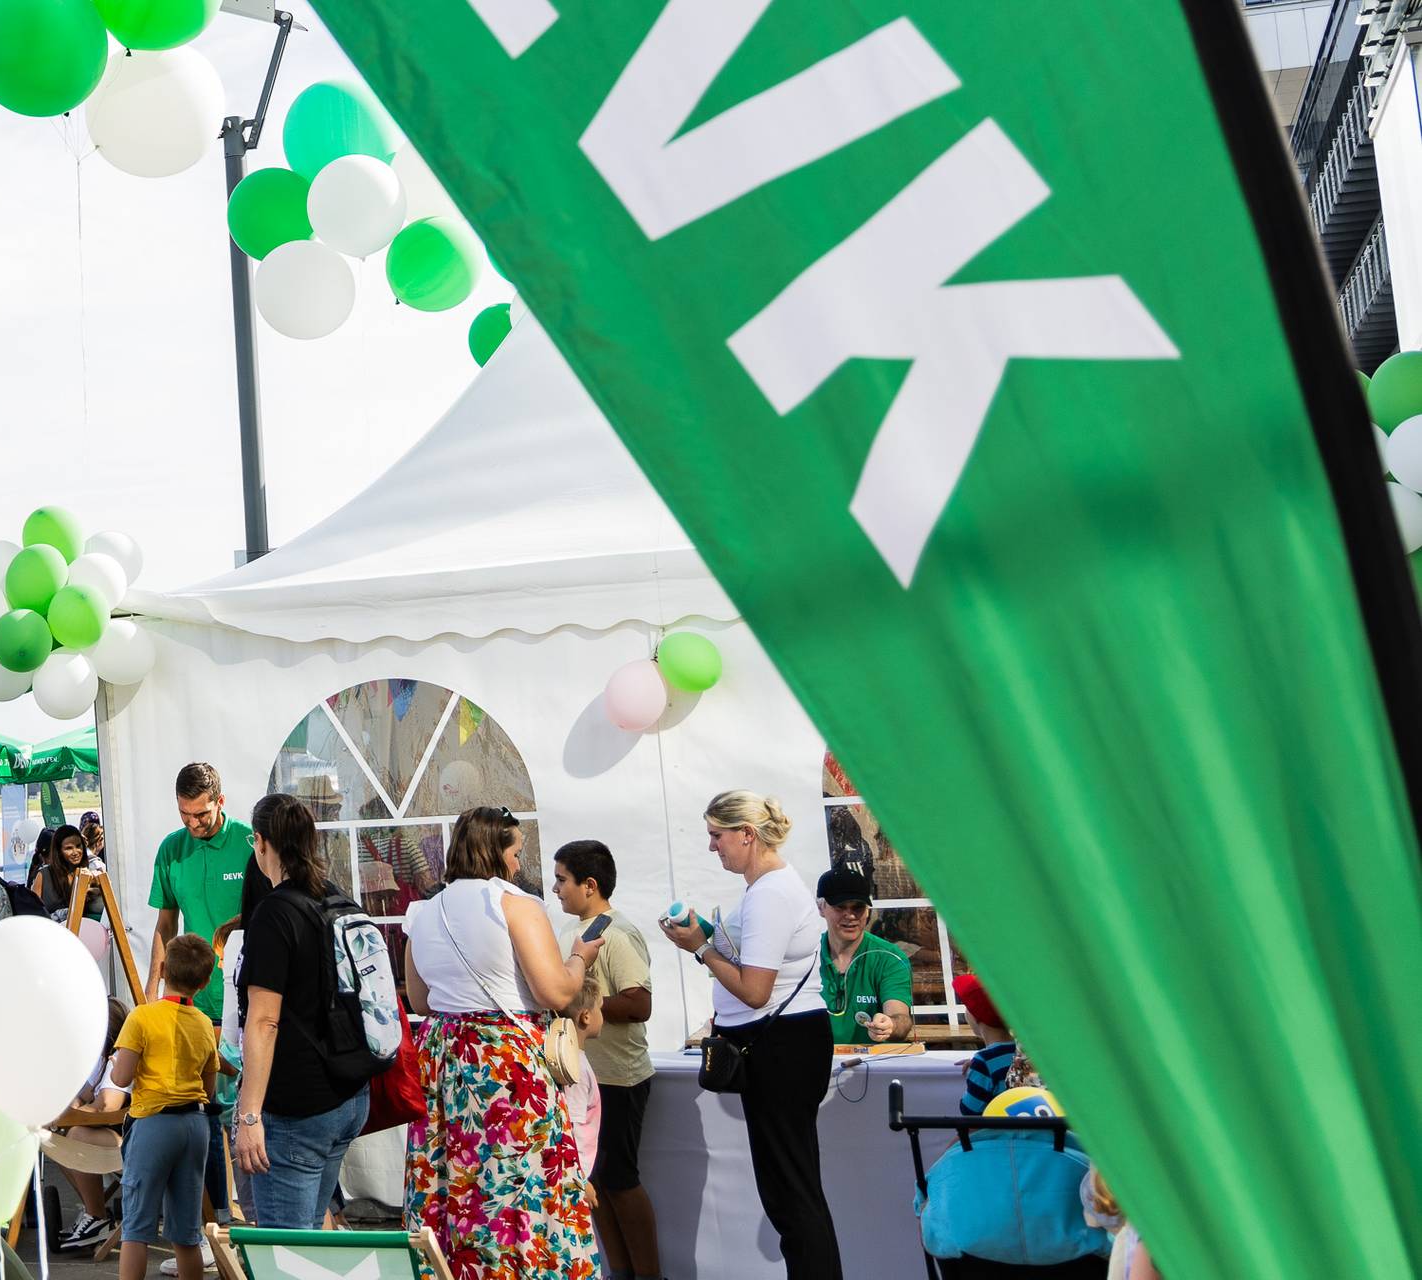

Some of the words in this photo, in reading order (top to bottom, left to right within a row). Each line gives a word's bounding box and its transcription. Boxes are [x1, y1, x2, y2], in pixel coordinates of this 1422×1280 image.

[470, 0, 1180, 590] VK
[223, 871, 244, 881] DEVK
[856, 995, 878, 1004] DEVK
